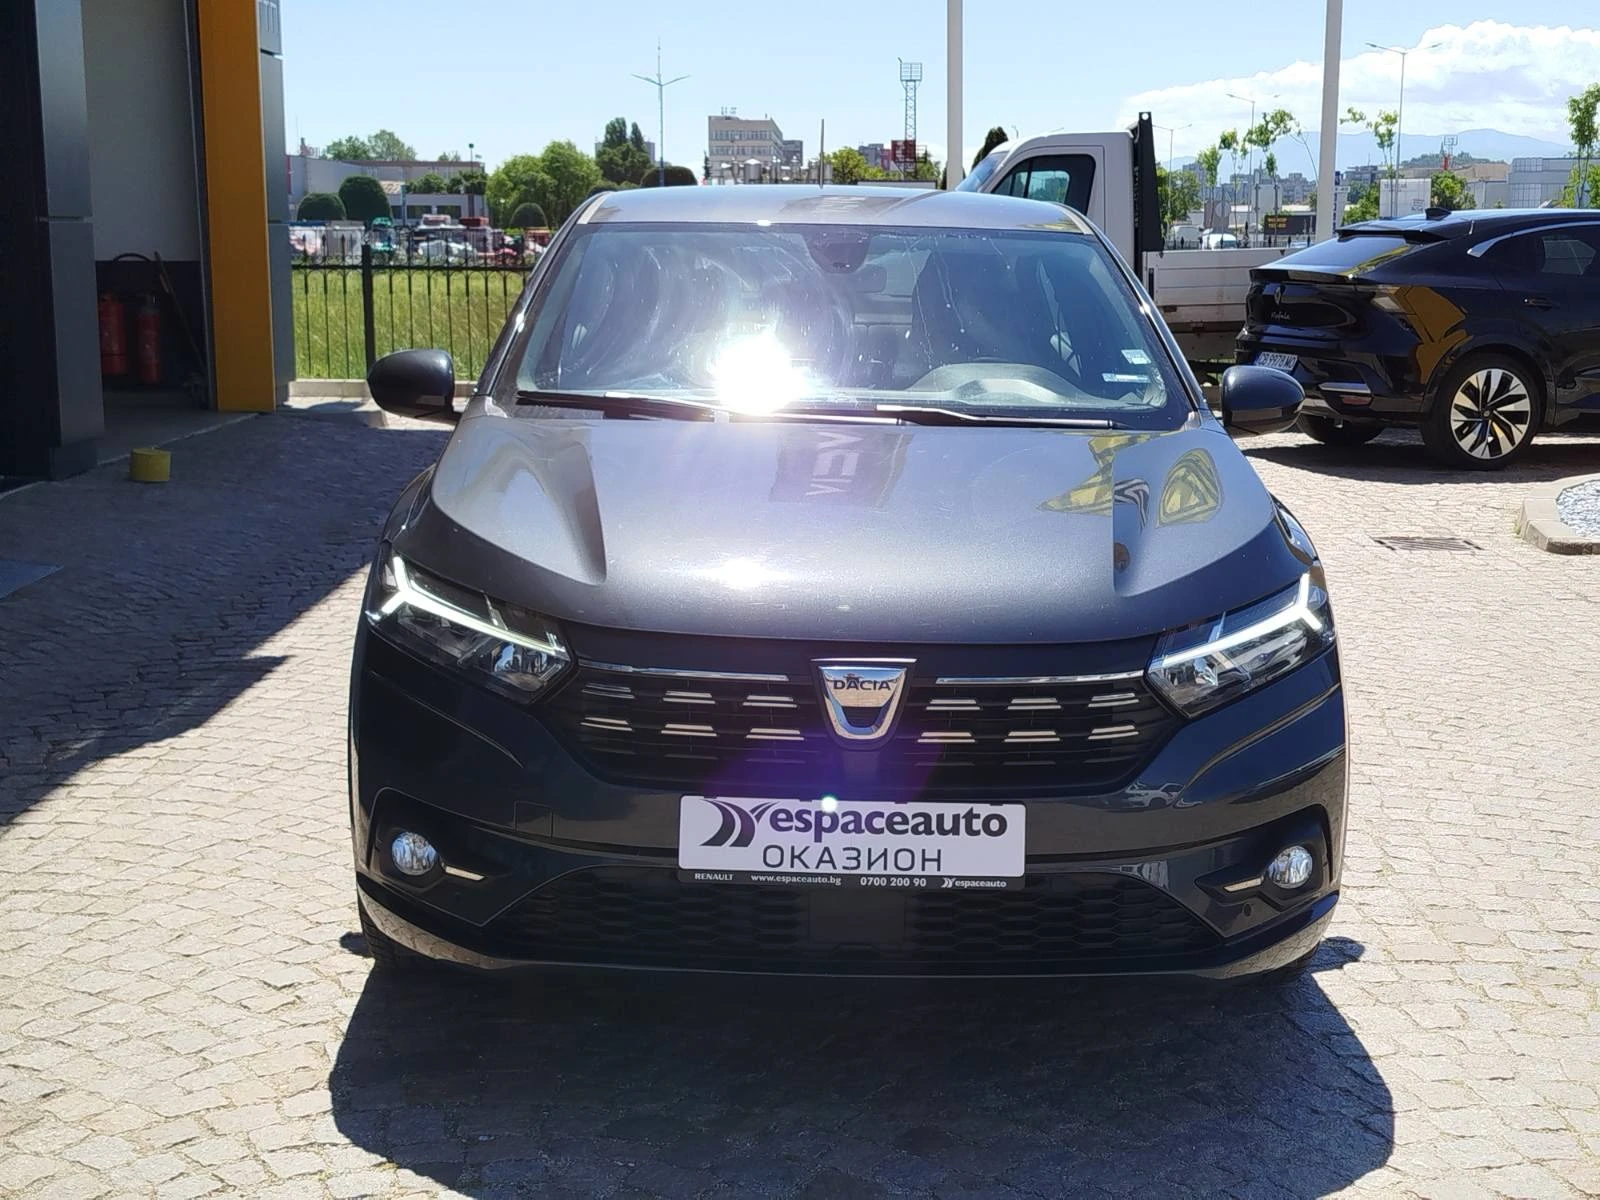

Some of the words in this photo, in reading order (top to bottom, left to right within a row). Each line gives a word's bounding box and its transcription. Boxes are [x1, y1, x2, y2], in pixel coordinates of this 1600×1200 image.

[833, 680, 891, 691] DACIA
[769, 805, 1008, 843] espaceauto
[762, 844, 942, 872] ОКАЗИОН
[694, 872, 734, 882] RENAULT
[750, 873, 842, 887] www.espaceauto.bg
[860, 876, 887, 887] 0700
[889, 877, 911, 888] 200
[912, 877, 927, 888] 90
[954, 878, 1007, 890] espaceauto
